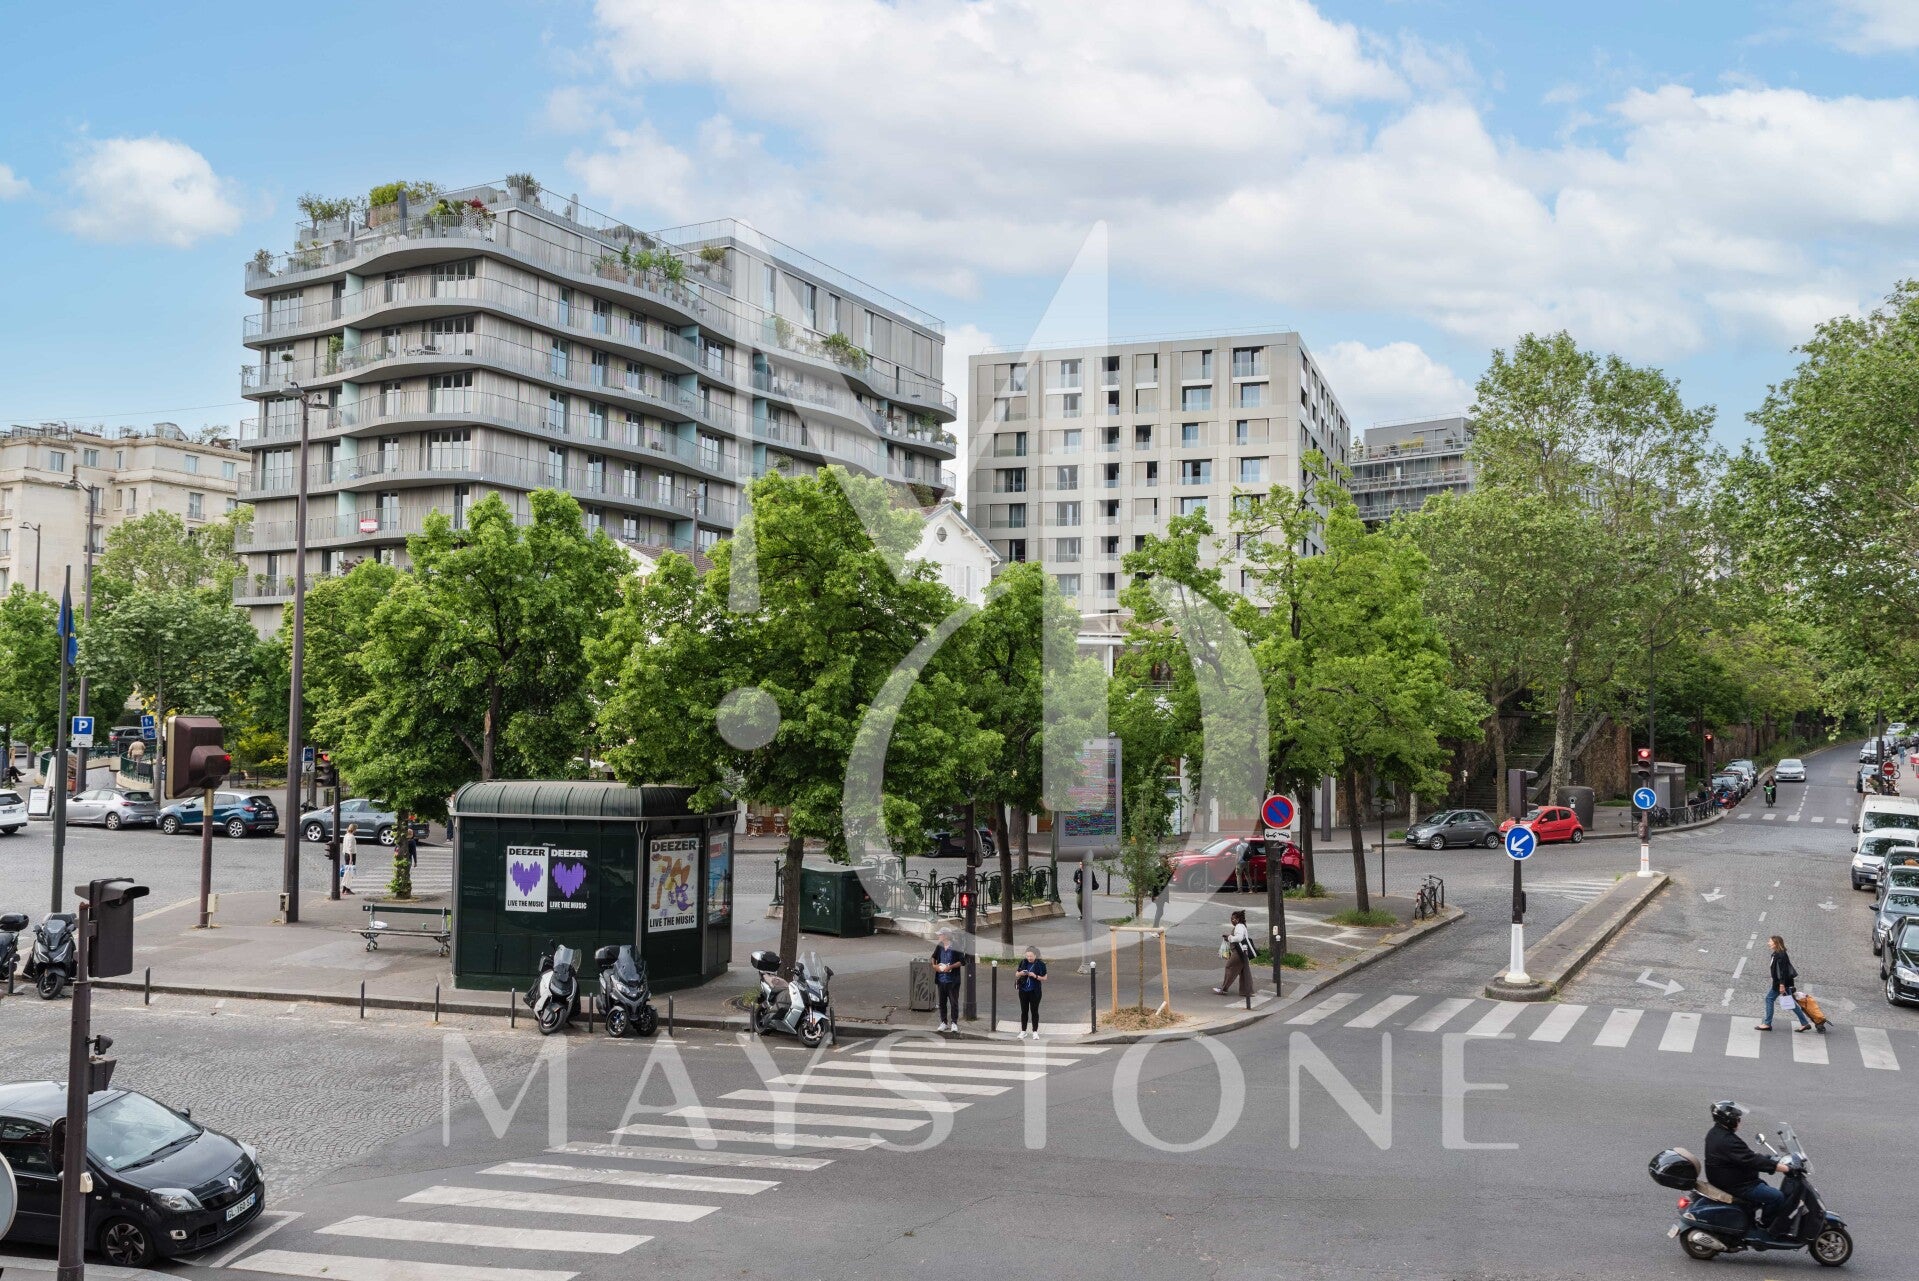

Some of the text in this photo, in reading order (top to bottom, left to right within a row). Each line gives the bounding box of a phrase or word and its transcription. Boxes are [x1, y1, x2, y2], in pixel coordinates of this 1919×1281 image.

[78, 720, 89, 732] P
[651, 840, 697, 853] DEEZER
[508, 848, 546, 857] DEEZER
[550, 849, 589, 858] DEEZER
[528, 900, 544, 908] MUSIC
[549, 901, 587, 910] LIVE THE MUSIC
[649, 914, 695, 928] LIVE THE MUSIC
